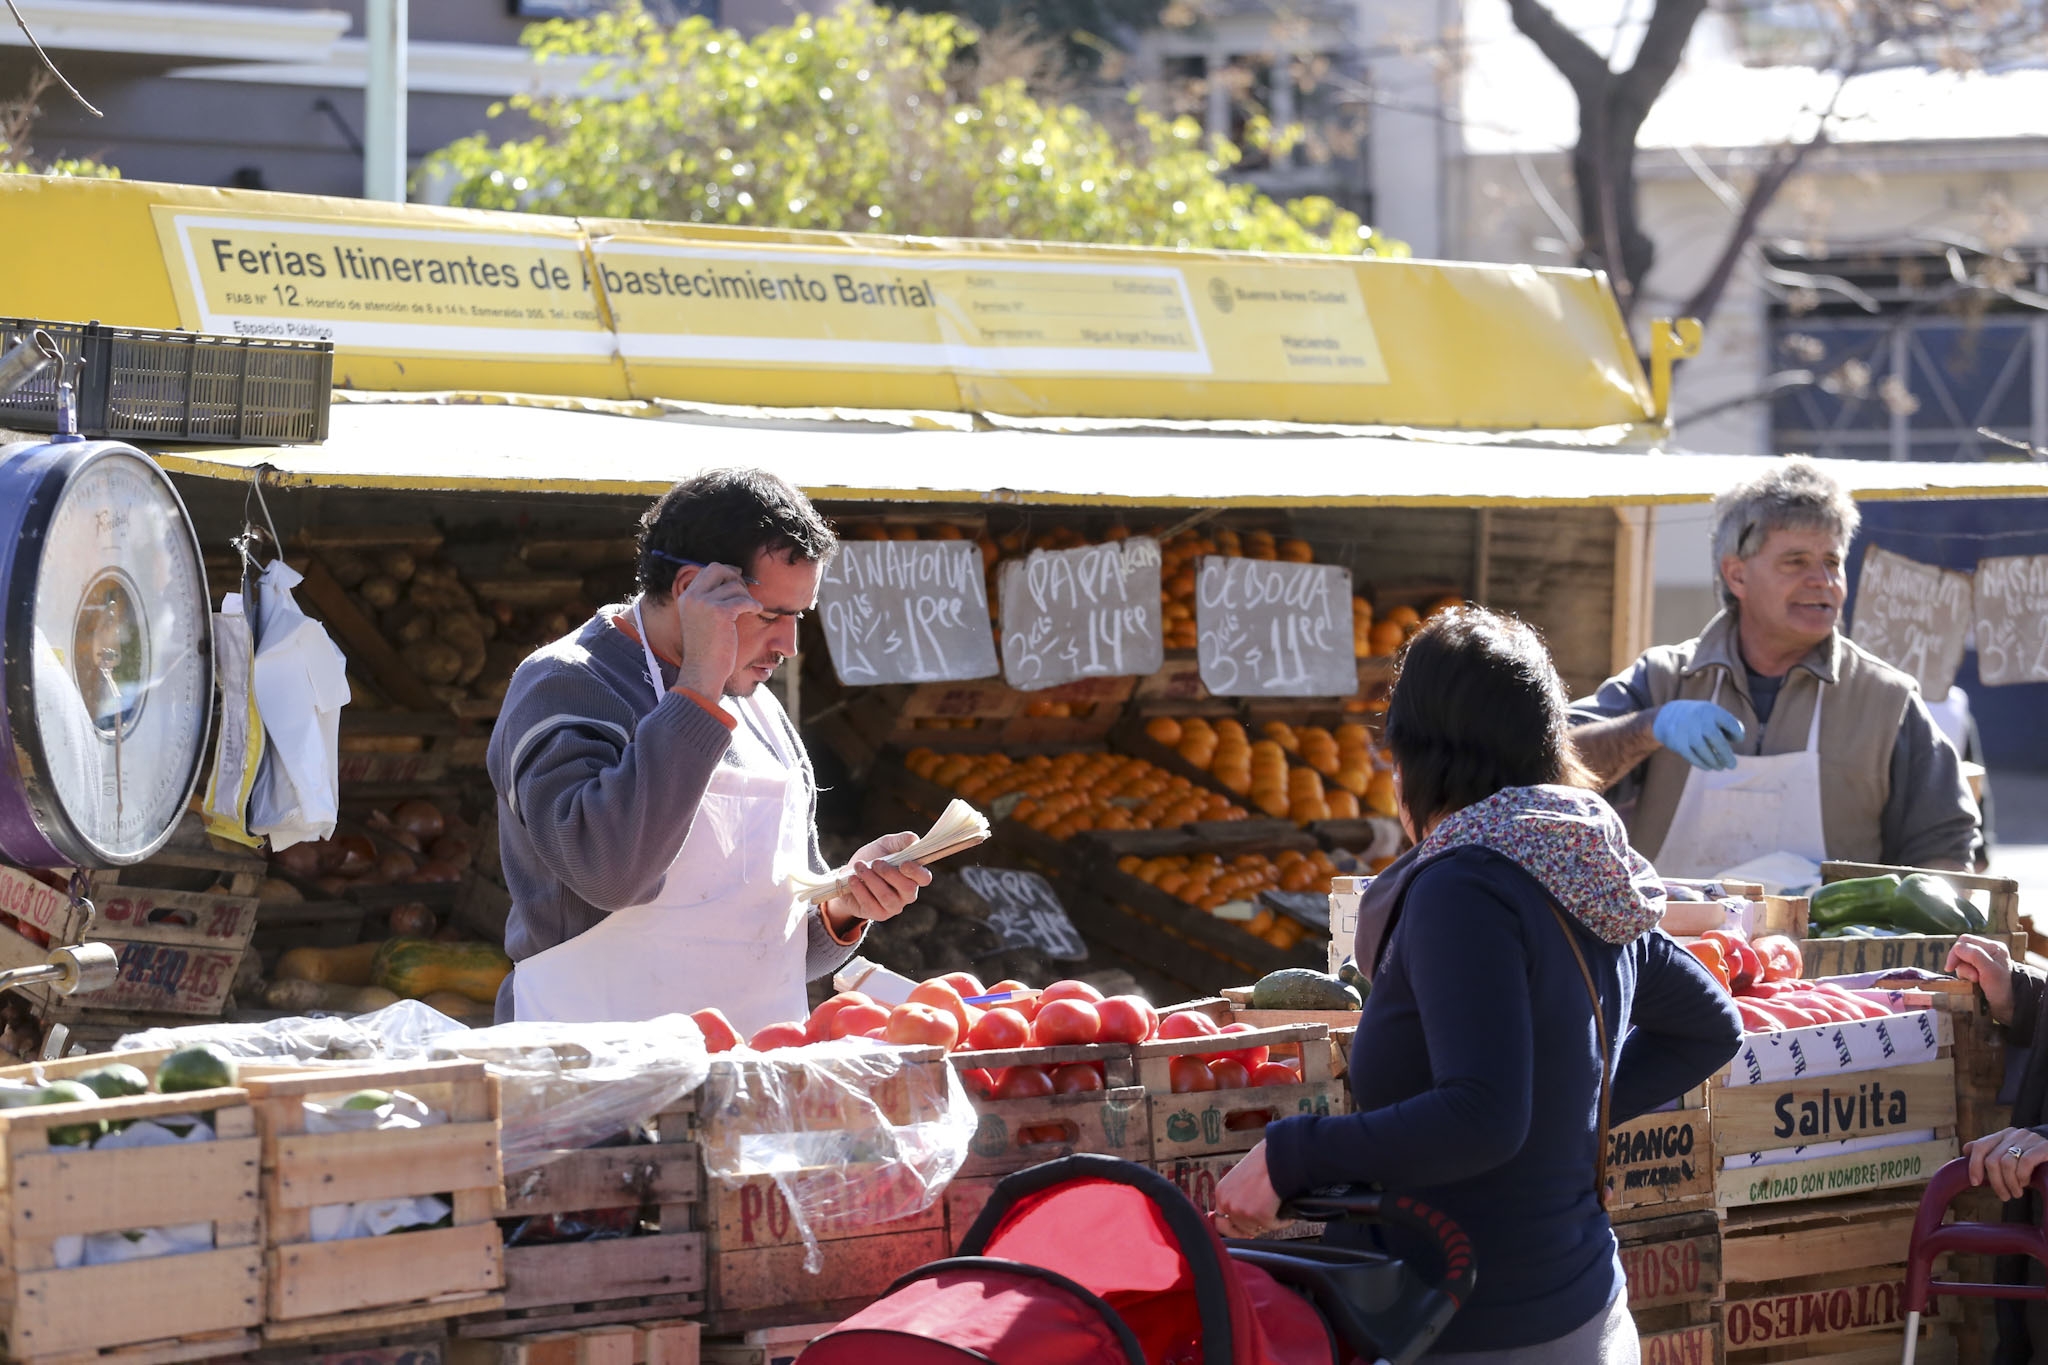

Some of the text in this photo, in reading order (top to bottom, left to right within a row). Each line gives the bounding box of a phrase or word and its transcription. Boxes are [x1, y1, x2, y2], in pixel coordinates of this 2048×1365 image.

[211, 239, 326, 278] Ferias
[334, 246, 520, 289] Itinerantes
[530, 258, 571, 290] de
[832, 274, 936, 309] Barrial
[233, 320, 333, 339] Espacio Público
[1028, 551, 1128, 613] PAPA
[1882, 940, 1953, 973] PLAT
[1774, 1081, 1907, 1139] Salvita
[1606, 1123, 1694, 1167] CHANGO
[1750, 1156, 1921, 1202] CALIDAD CON NOMBRE PROPIO
